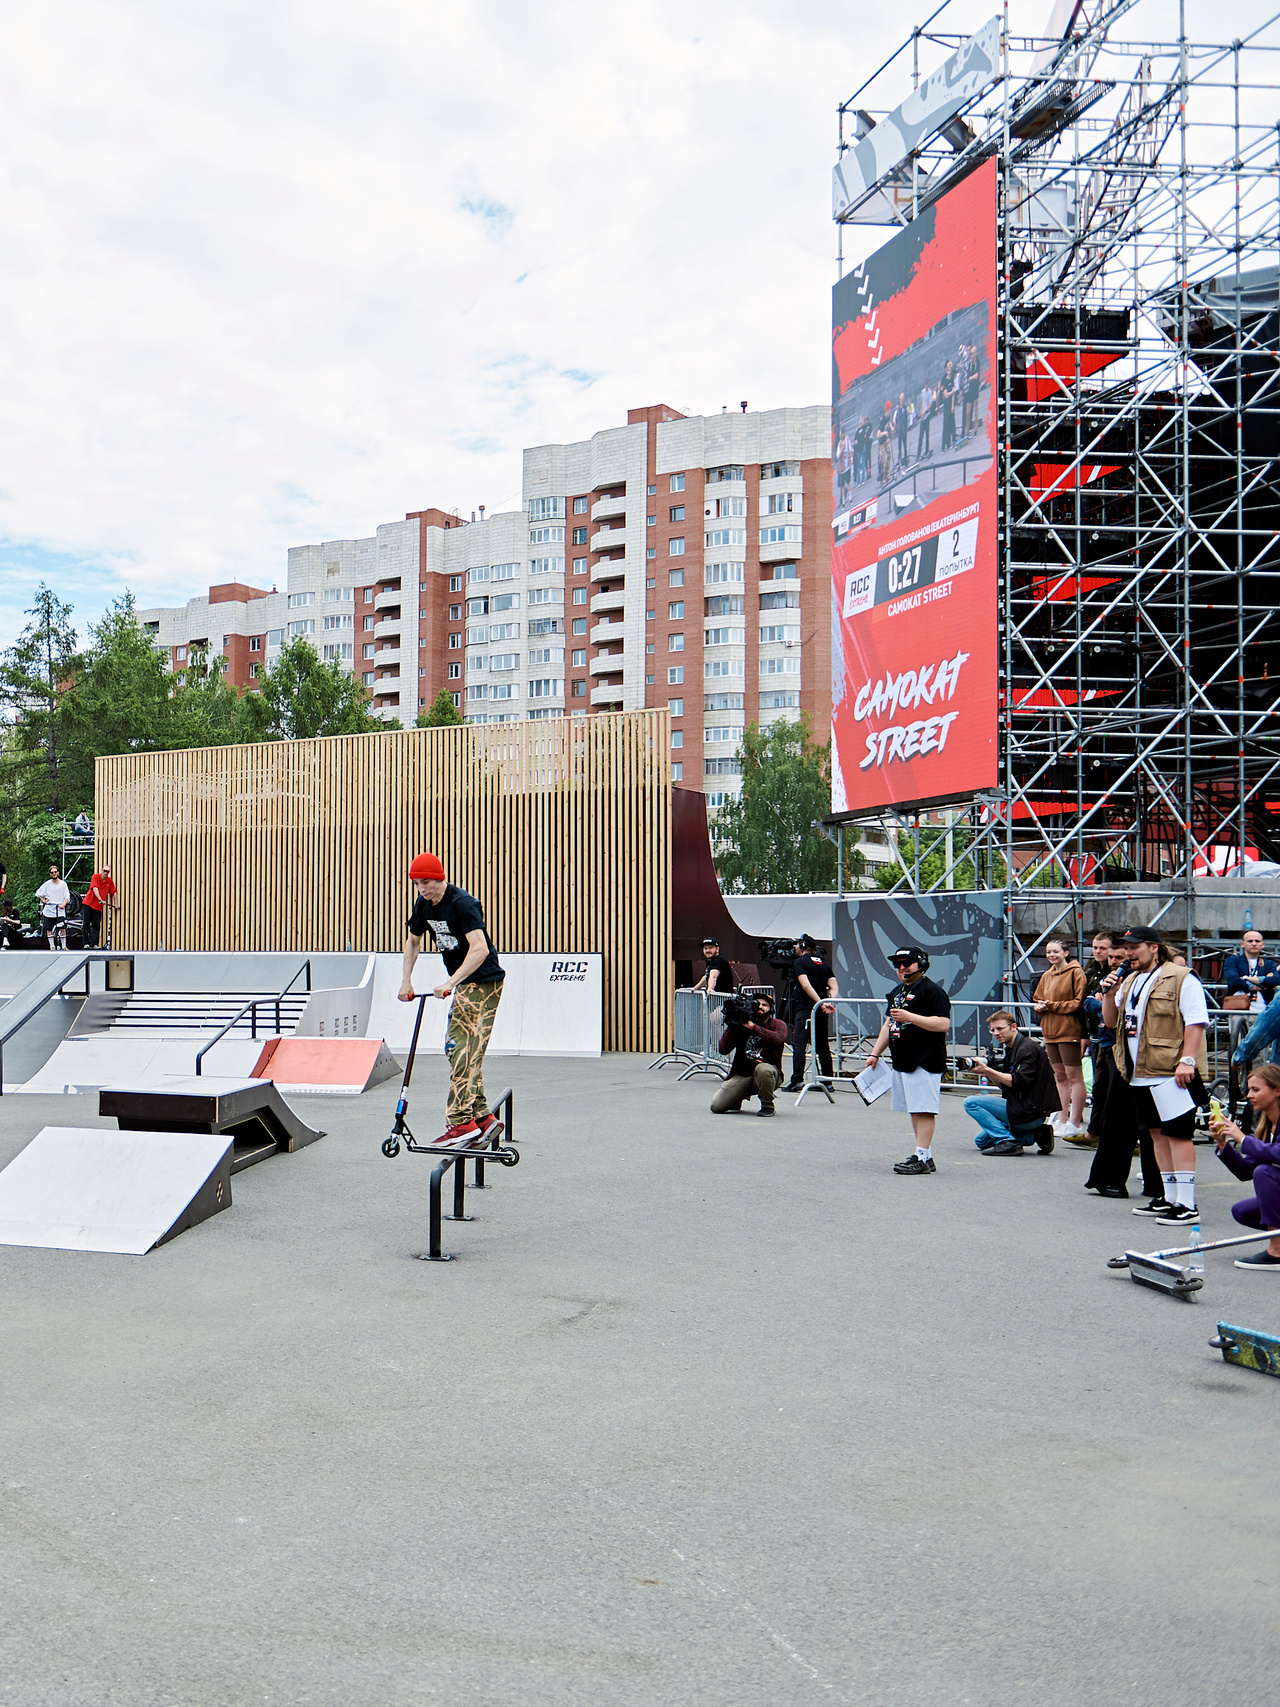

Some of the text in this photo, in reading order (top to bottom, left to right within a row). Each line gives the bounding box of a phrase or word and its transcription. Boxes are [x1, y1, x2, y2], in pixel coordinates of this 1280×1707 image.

[878, 539, 897, 557] АНТОН
[897, 524, 931, 548] ГОЛОВАНОВ
[952, 529, 960, 558] 2
[888, 545, 922, 594] 0:27
[939, 556, 973, 578] ПОПЫТКА
[850, 575, 870, 598] RCC
[887, 581, 953, 617] САМОКАТ STREET
[854, 649, 970, 722] САМОКАТ
[859, 711, 960, 769] STREET
[549, 974, 586, 982] EXTREME
[551, 961, 589, 973] RCC
